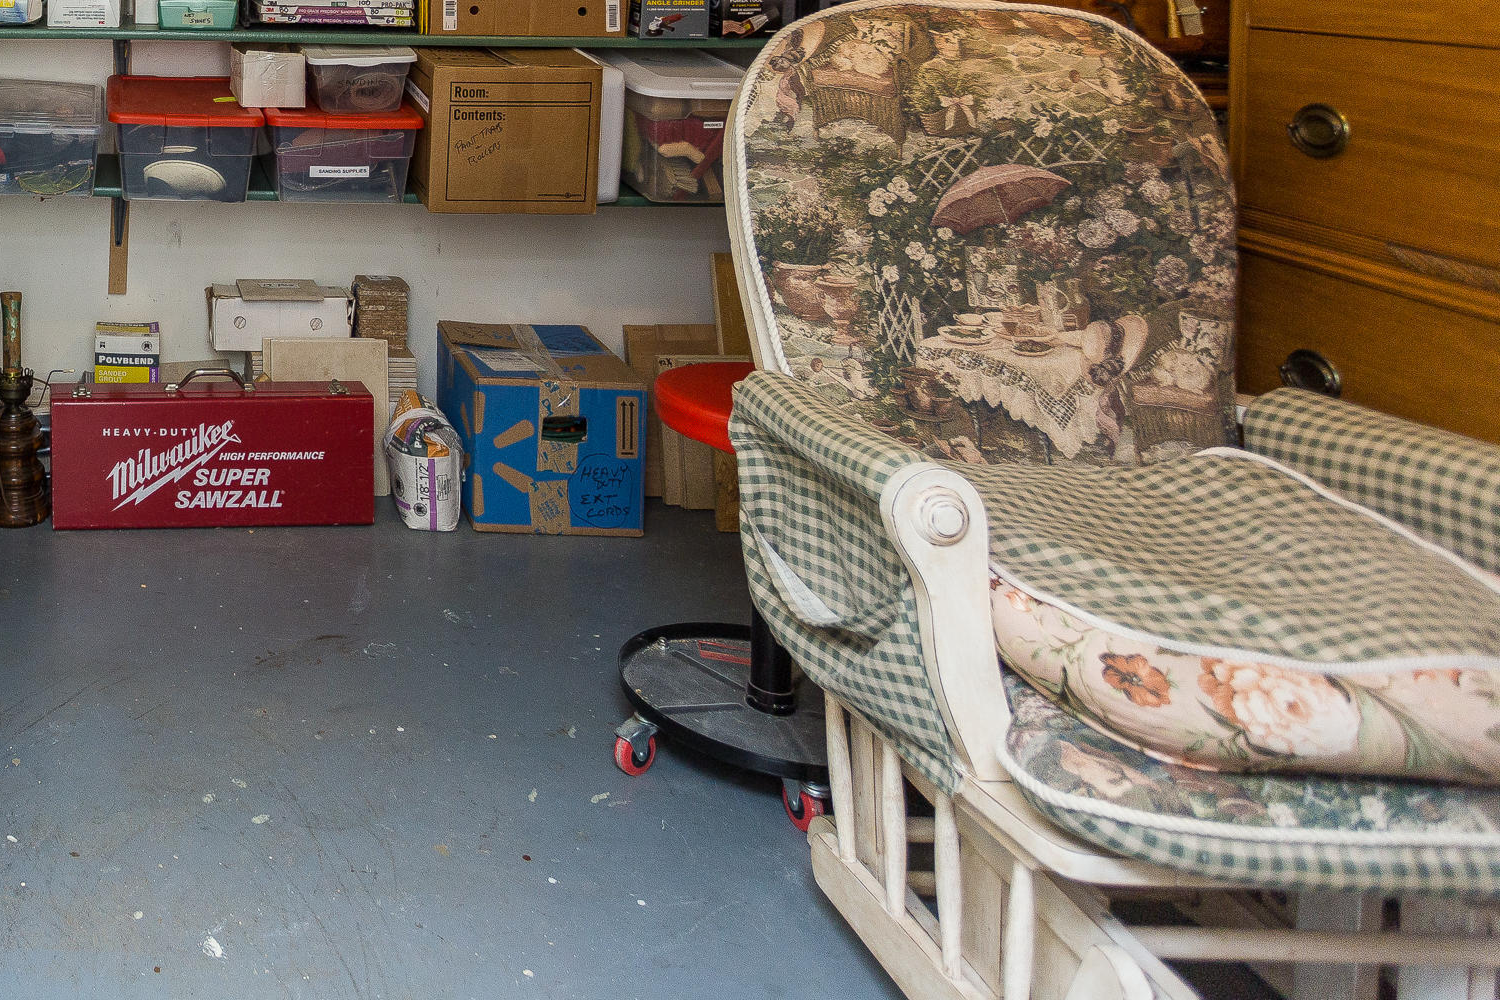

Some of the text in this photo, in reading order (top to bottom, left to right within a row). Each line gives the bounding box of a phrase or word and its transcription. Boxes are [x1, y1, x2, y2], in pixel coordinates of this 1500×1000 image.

[454, 86, 489, 98] Room:
[454, 108, 506, 120] Contents:
[455, 134, 478, 154] PAINT
[98, 356, 154, 365] POLYBLEND
[105, 420, 234, 500] Milwaukee
[218, 451, 325, 460] HIGH PERFORMANCE
[193, 468, 271, 486] SUPER
[580, 464, 628, 482] HEAVY
[174, 490, 284, 508] SAWZALL
[580, 494, 618, 506] EXT
[586, 504, 630, 518] CORDS
